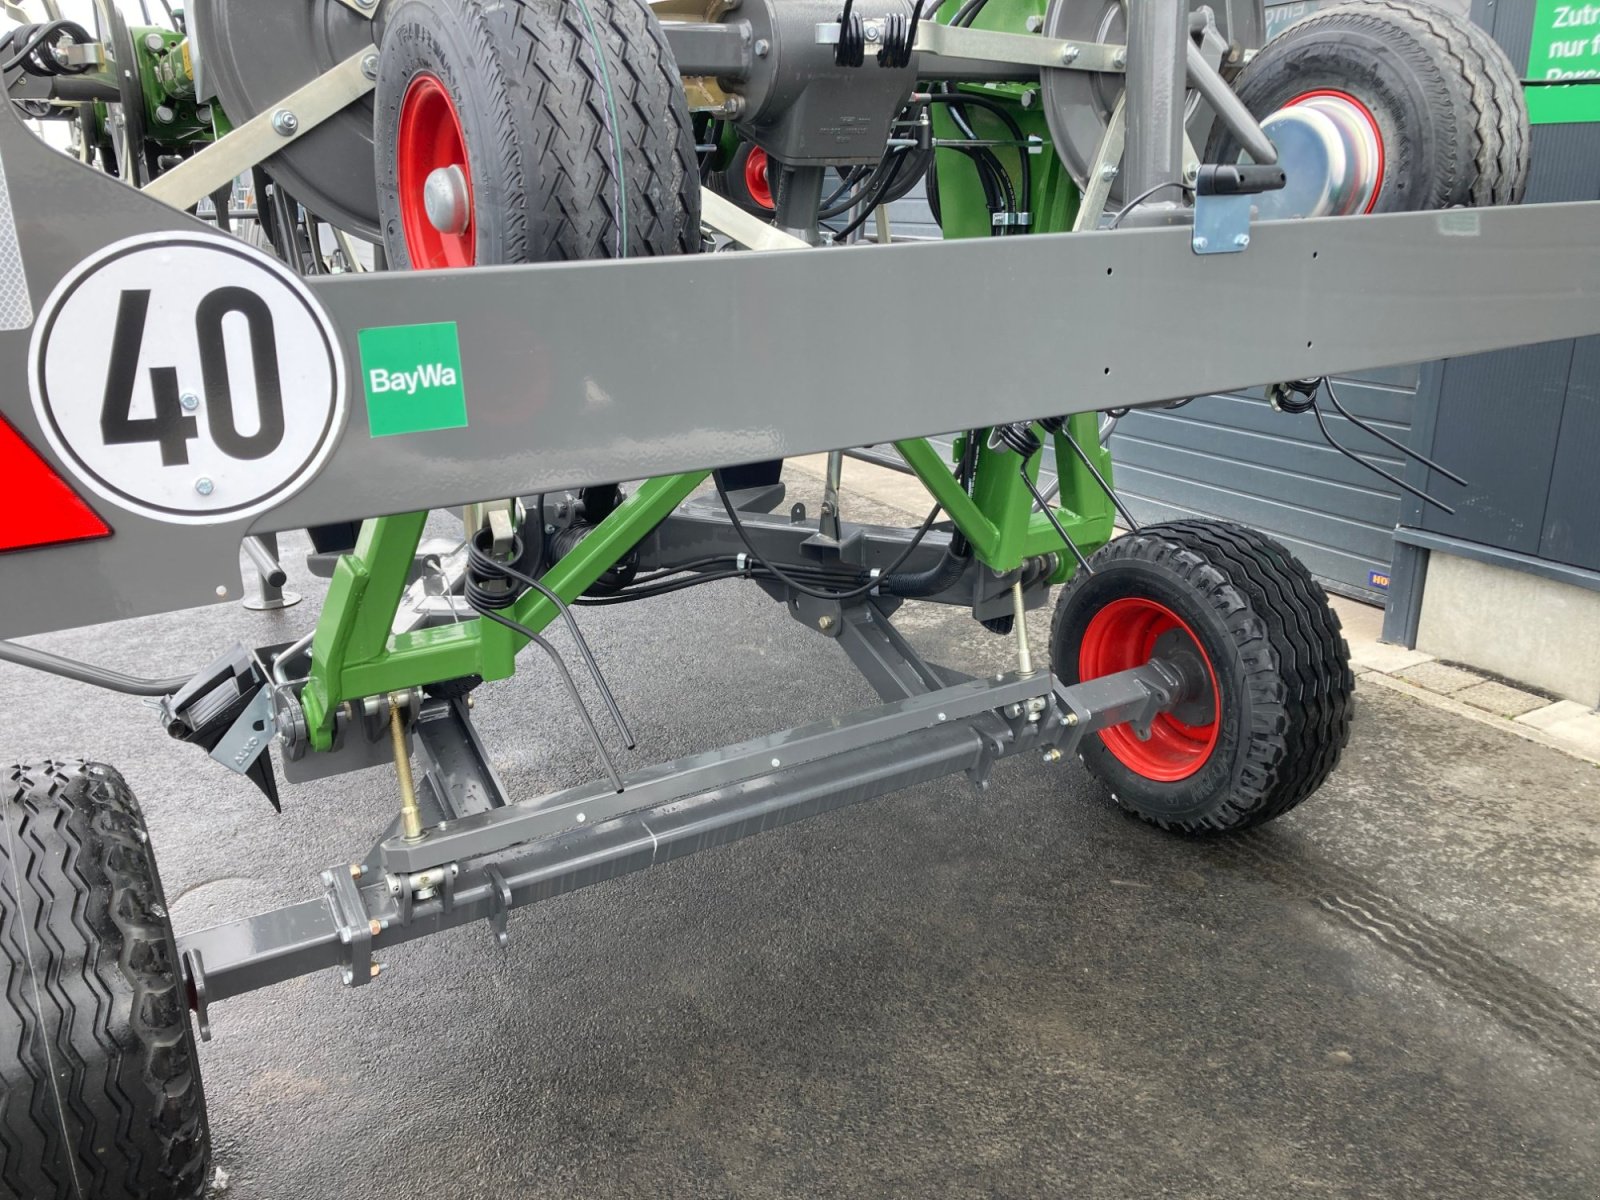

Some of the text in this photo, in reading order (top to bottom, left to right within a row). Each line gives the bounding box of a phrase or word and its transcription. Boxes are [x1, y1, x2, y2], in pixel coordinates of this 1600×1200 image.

[1548, 39, 1590, 59] nur
[100, 286, 285, 467] 40
[369, 363, 457, 395] BayWa
